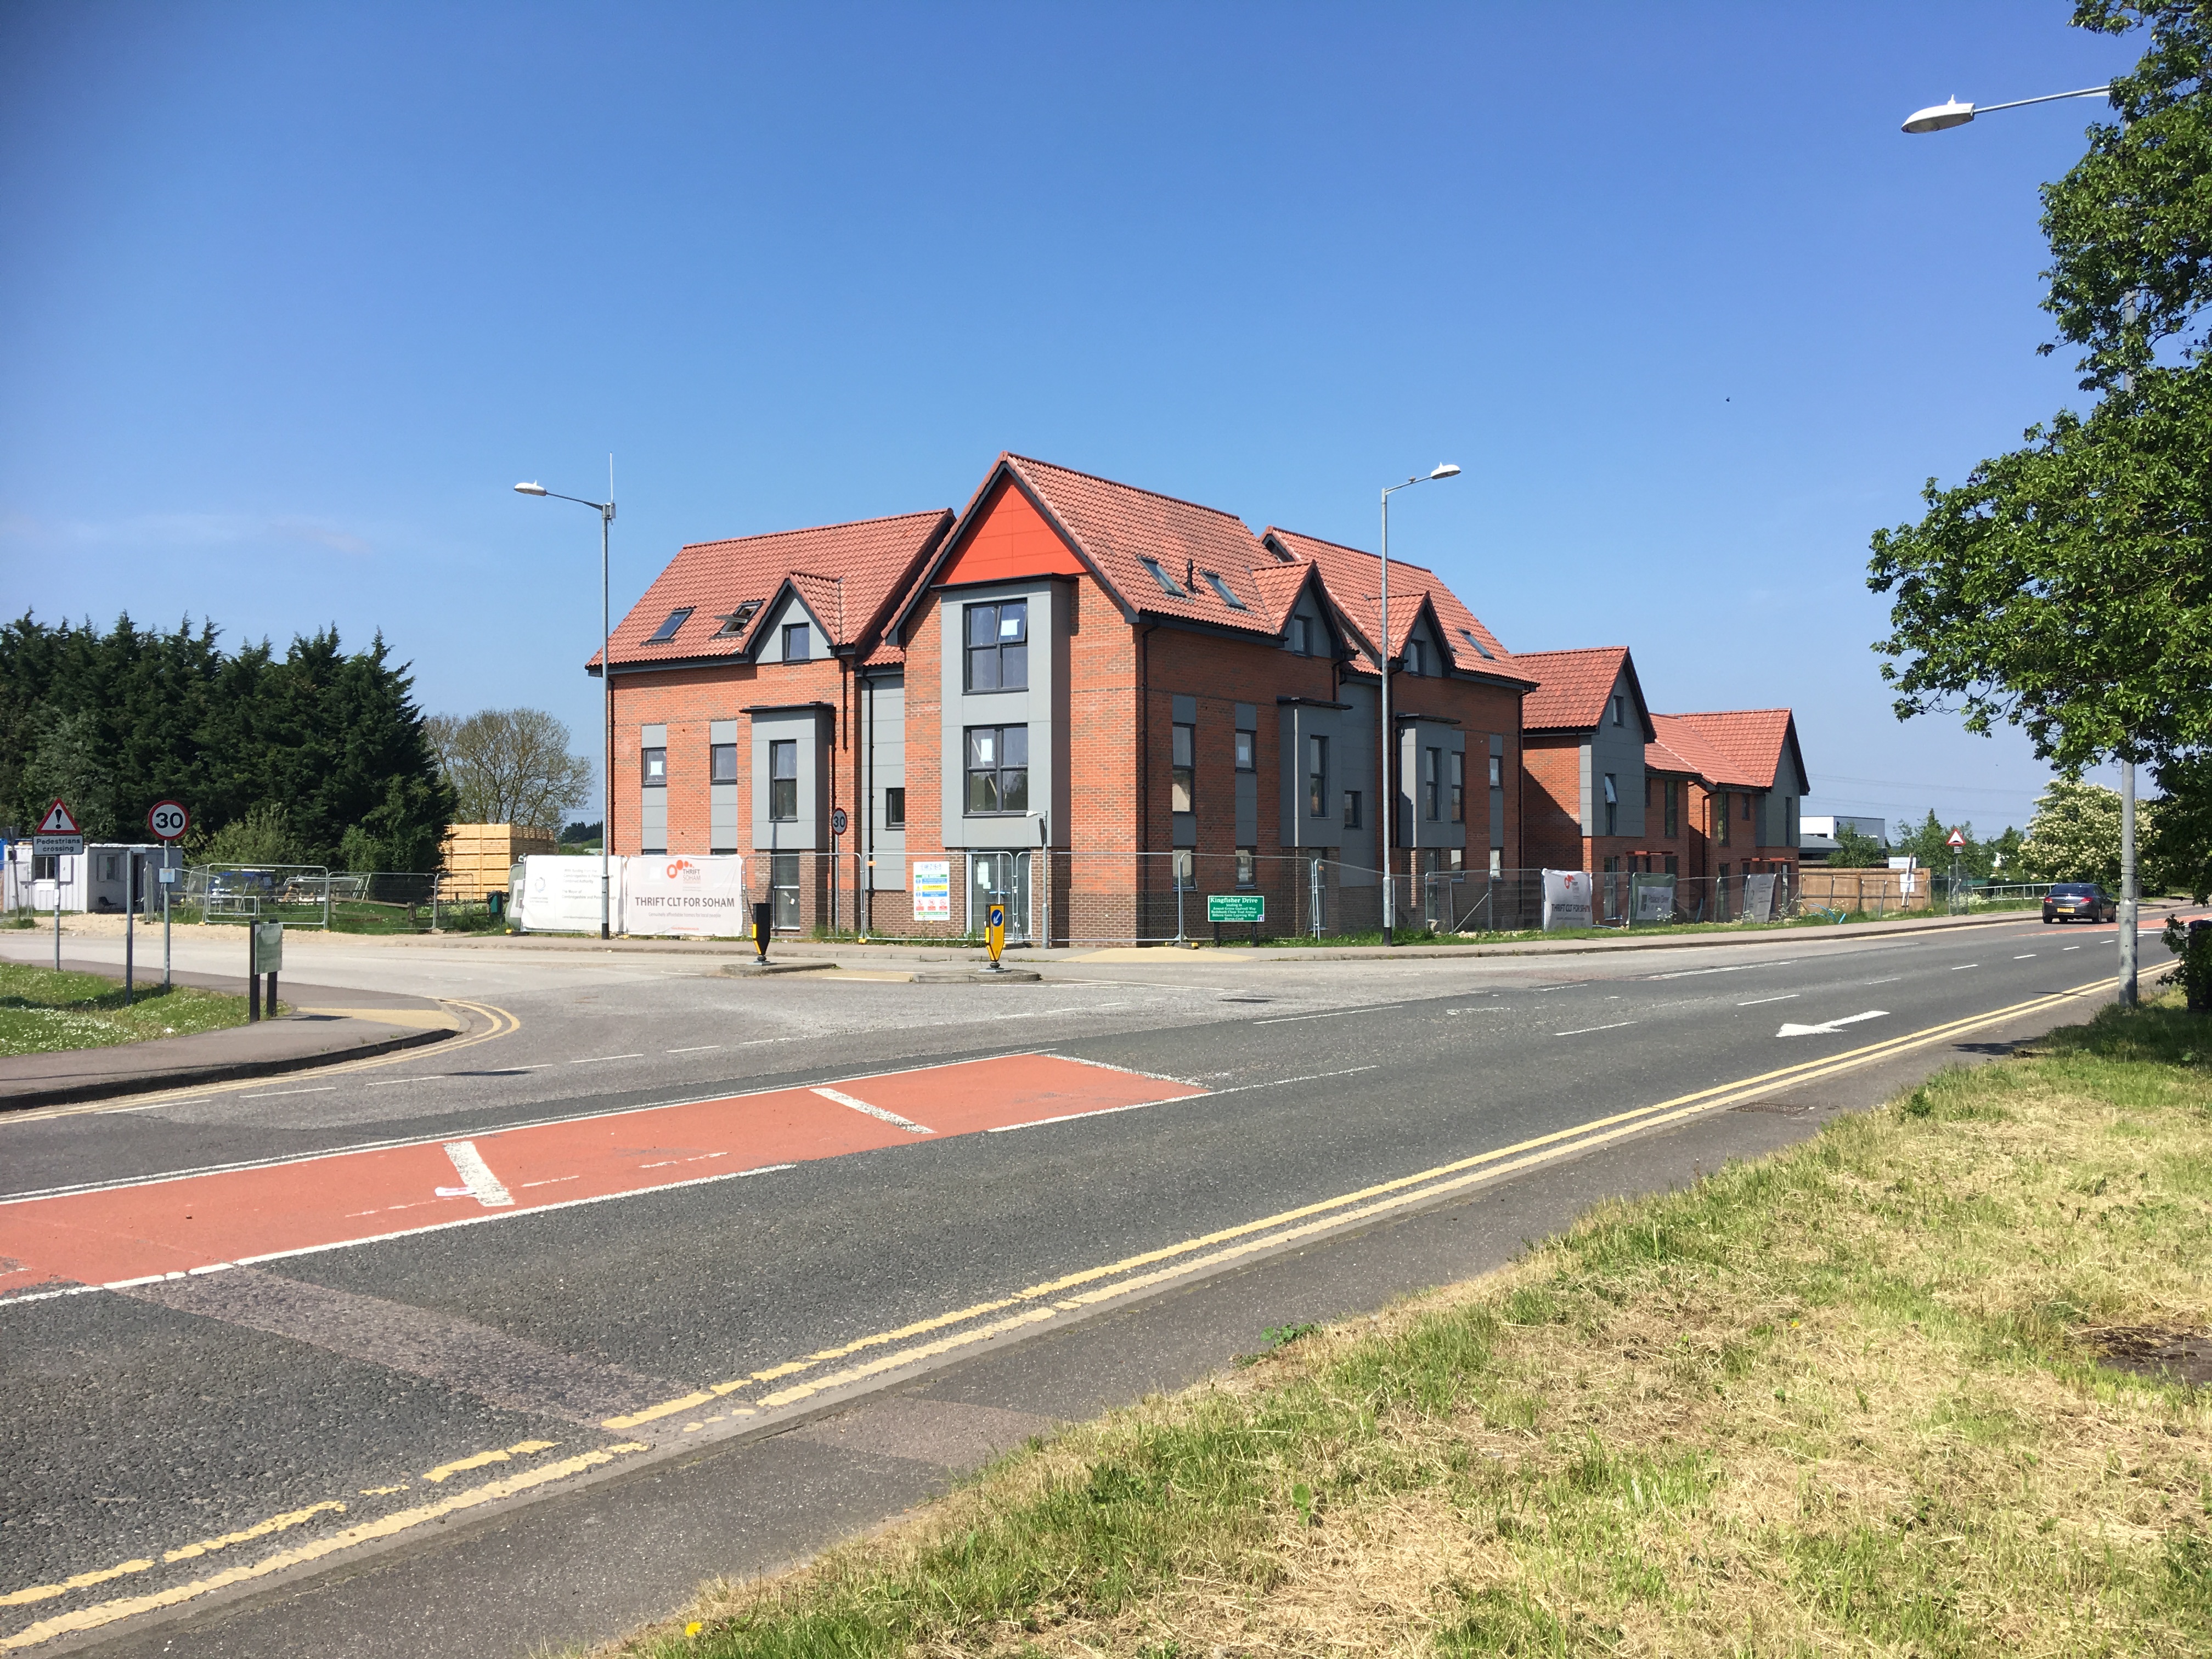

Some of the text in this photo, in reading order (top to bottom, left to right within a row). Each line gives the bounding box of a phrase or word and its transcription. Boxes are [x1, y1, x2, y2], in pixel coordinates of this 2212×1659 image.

[155, 812, 183, 829] 30
[833, 816, 845, 828] 30
[635, 897, 735, 907] THRIFT CLT FOR SOHAM
